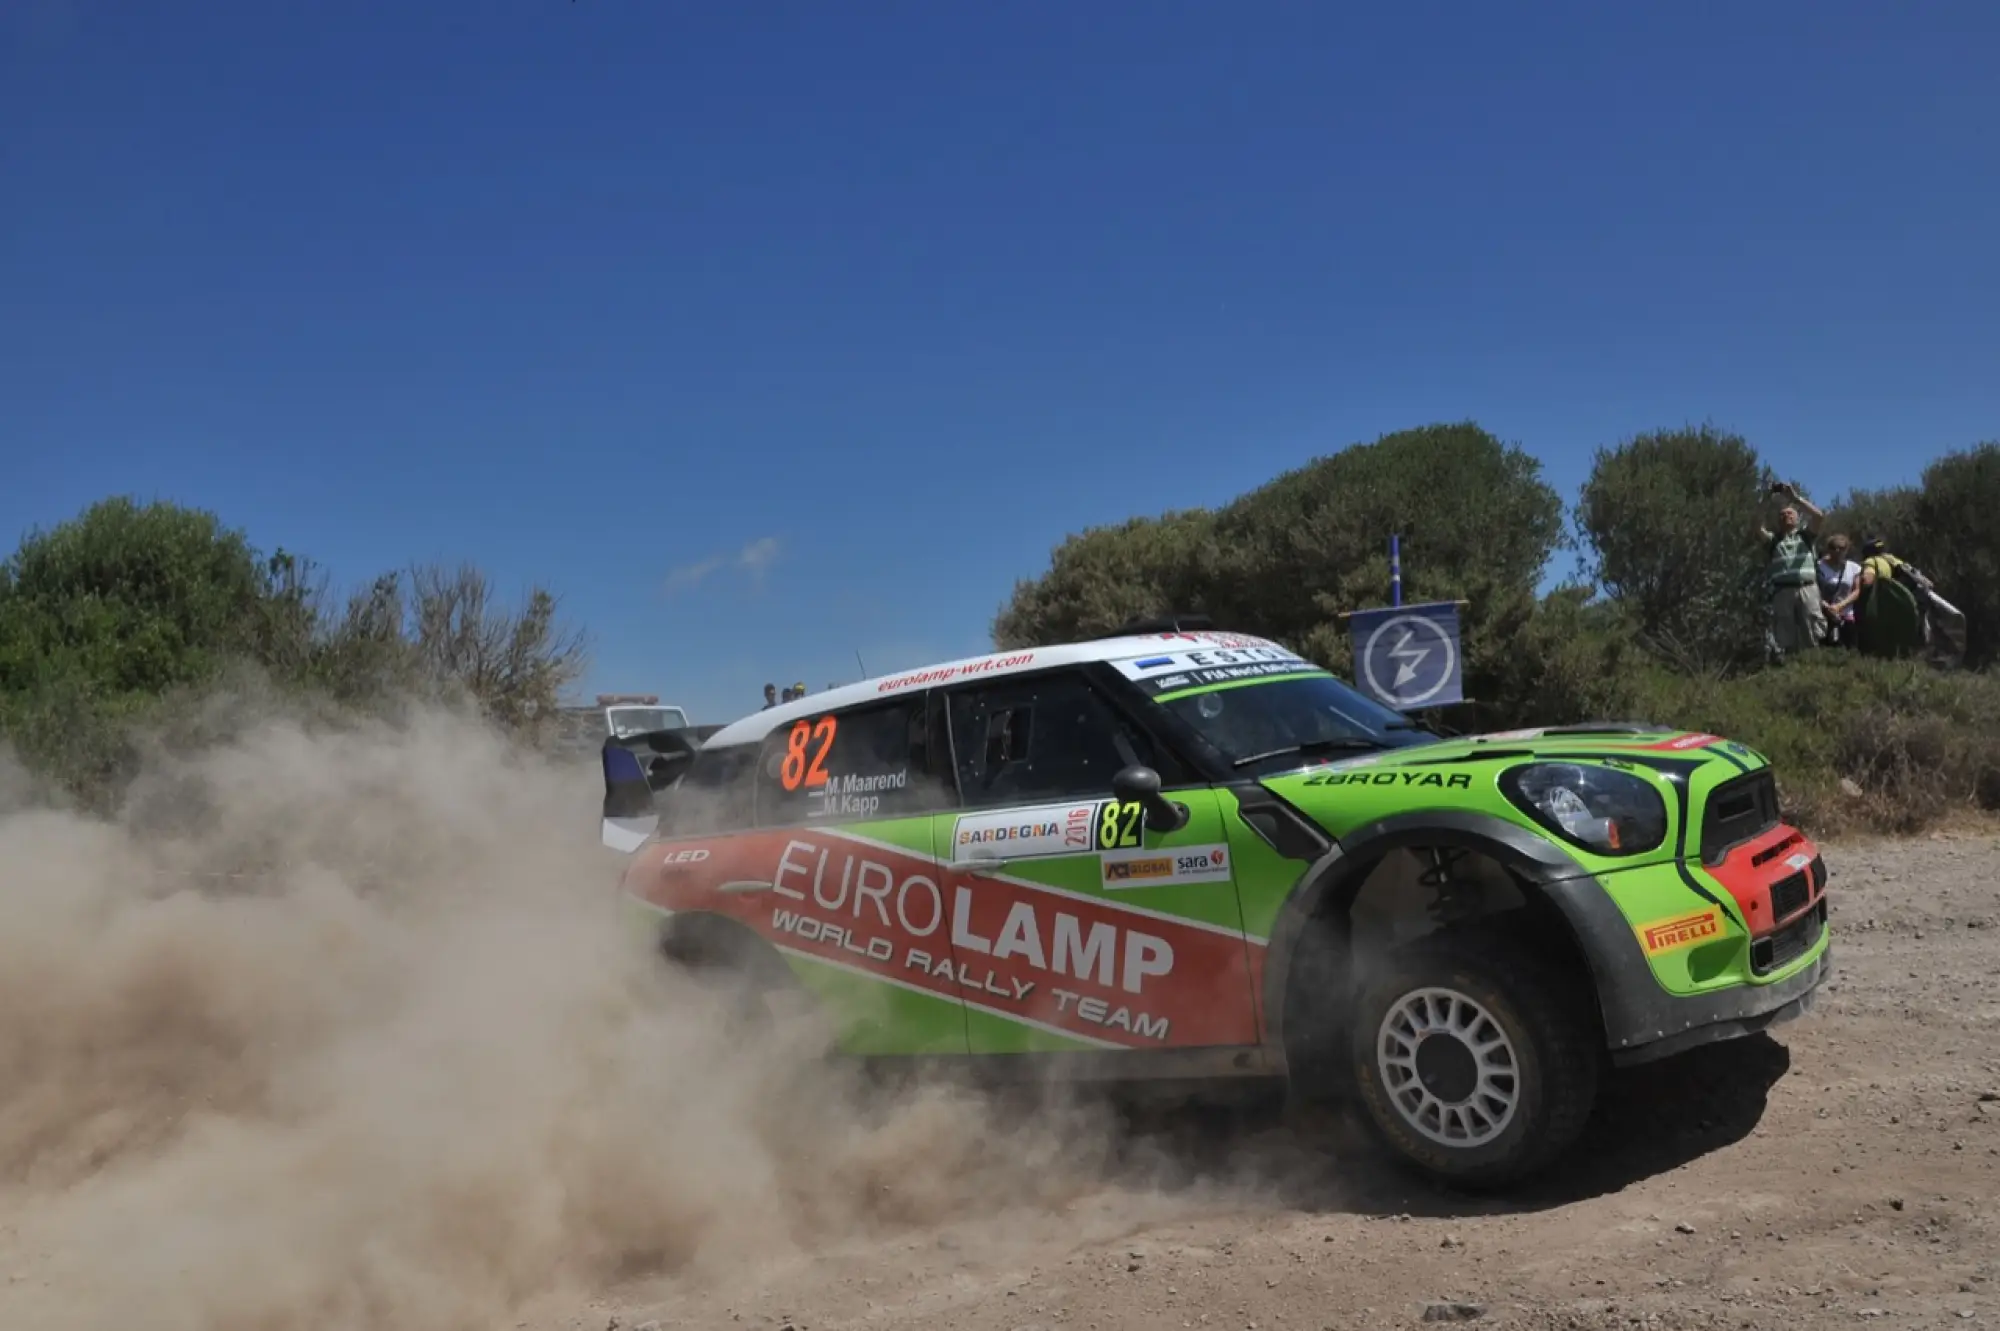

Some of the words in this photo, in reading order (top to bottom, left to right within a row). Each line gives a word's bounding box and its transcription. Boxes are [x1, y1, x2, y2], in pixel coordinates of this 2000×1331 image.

[877, 653, 1034, 692] eurolamp-wrt.com
[781, 715, 837, 791] 82
[824, 778, 841, 796] M.
[843, 768, 906, 793] Maarend
[824, 799, 840, 815] M.
[841, 795, 879, 817] Kapp
[1100, 800, 1140, 848] 82
[959, 822, 1060, 845] SARDEGNA
[1064, 808, 1090, 847] 2016
[664, 849, 710, 864] LED
[1130, 859, 1172, 875] GLOBAL
[1177, 855, 1208, 869] sara
[773, 839, 1173, 994] EUROLAMP
[1644, 913, 1716, 951] PIRELLI
[772, 908, 893, 961] WORLD
[905, 948, 1035, 1000] RALLY
[1051, 988, 1169, 1040] TEAM
